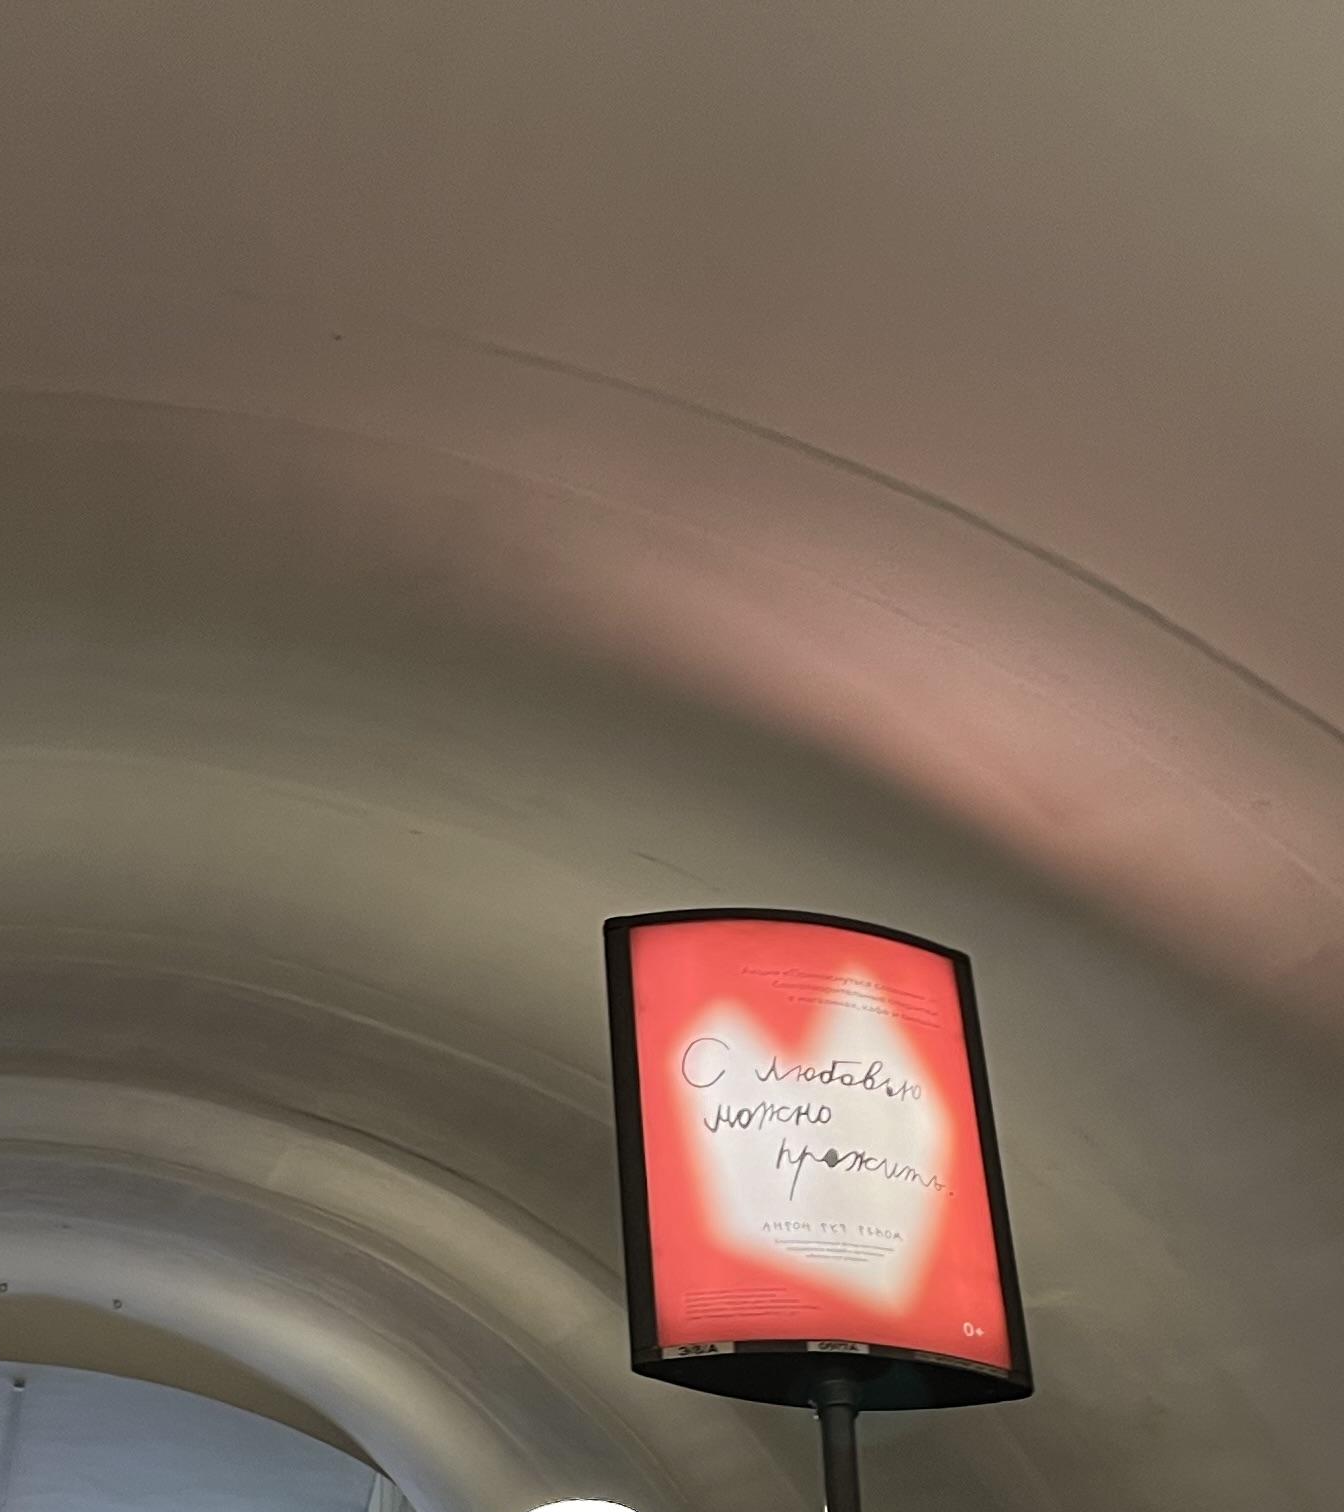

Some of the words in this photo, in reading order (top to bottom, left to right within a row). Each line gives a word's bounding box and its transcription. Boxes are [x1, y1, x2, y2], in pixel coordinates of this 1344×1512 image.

[682, 1037, 730, 1088] С
[755, 1055, 922, 1102] любовью
[704, 1100, 832, 1133] можно
[962, 1321, 985, 1338] 0+
